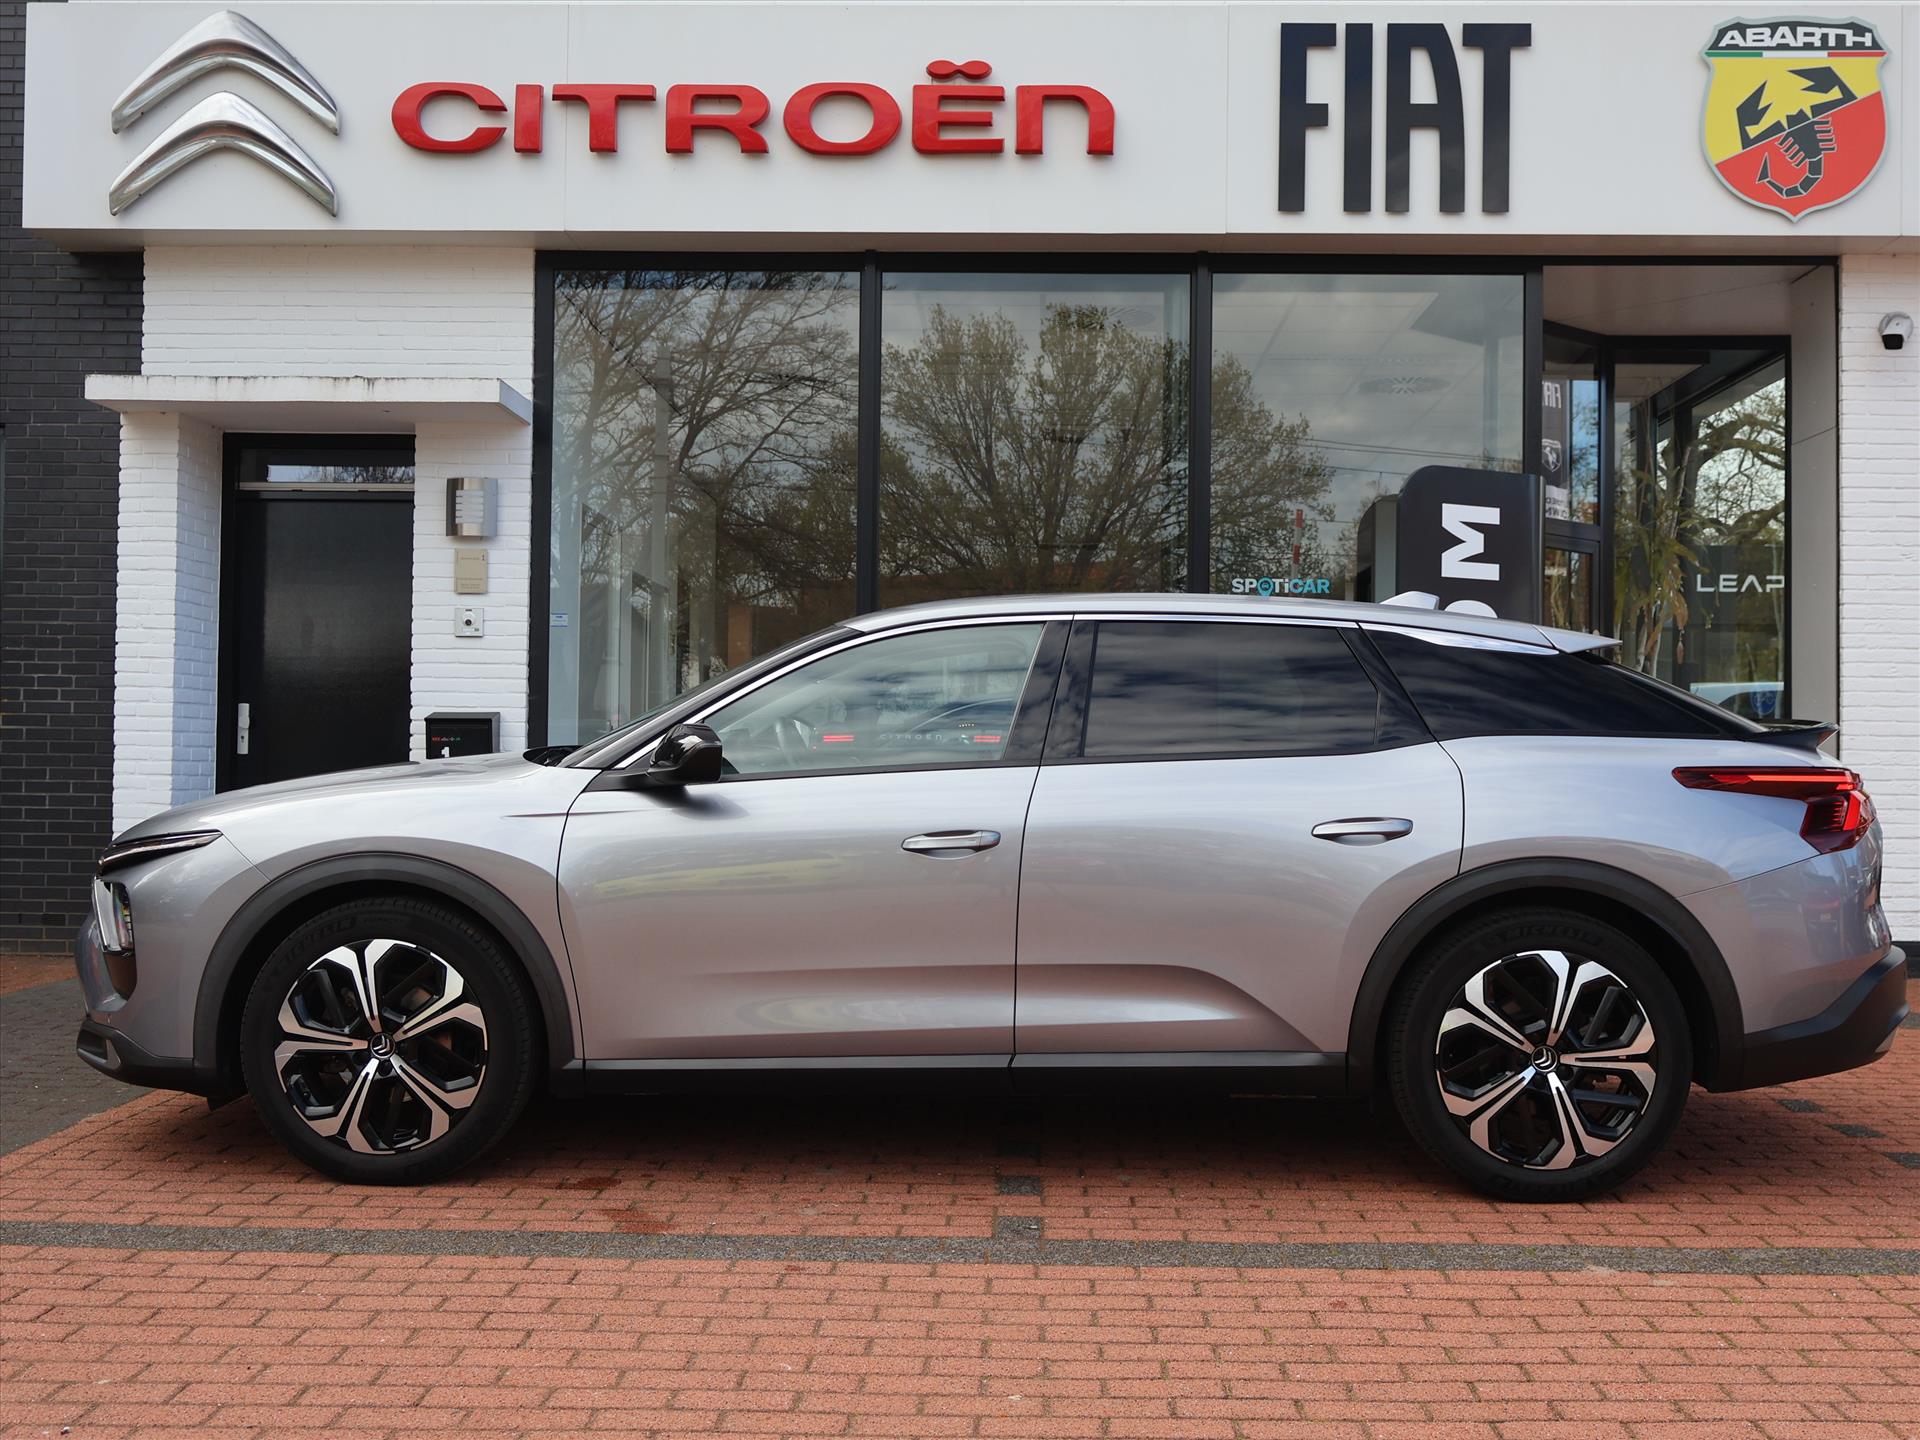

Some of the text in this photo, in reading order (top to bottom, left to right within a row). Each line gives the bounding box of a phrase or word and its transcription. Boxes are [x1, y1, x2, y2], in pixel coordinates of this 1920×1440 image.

[1718, 26, 1873, 47] ABARTH
[391, 60, 1116, 155] CITROËN
[1278, 23, 1532, 213] FIAT
